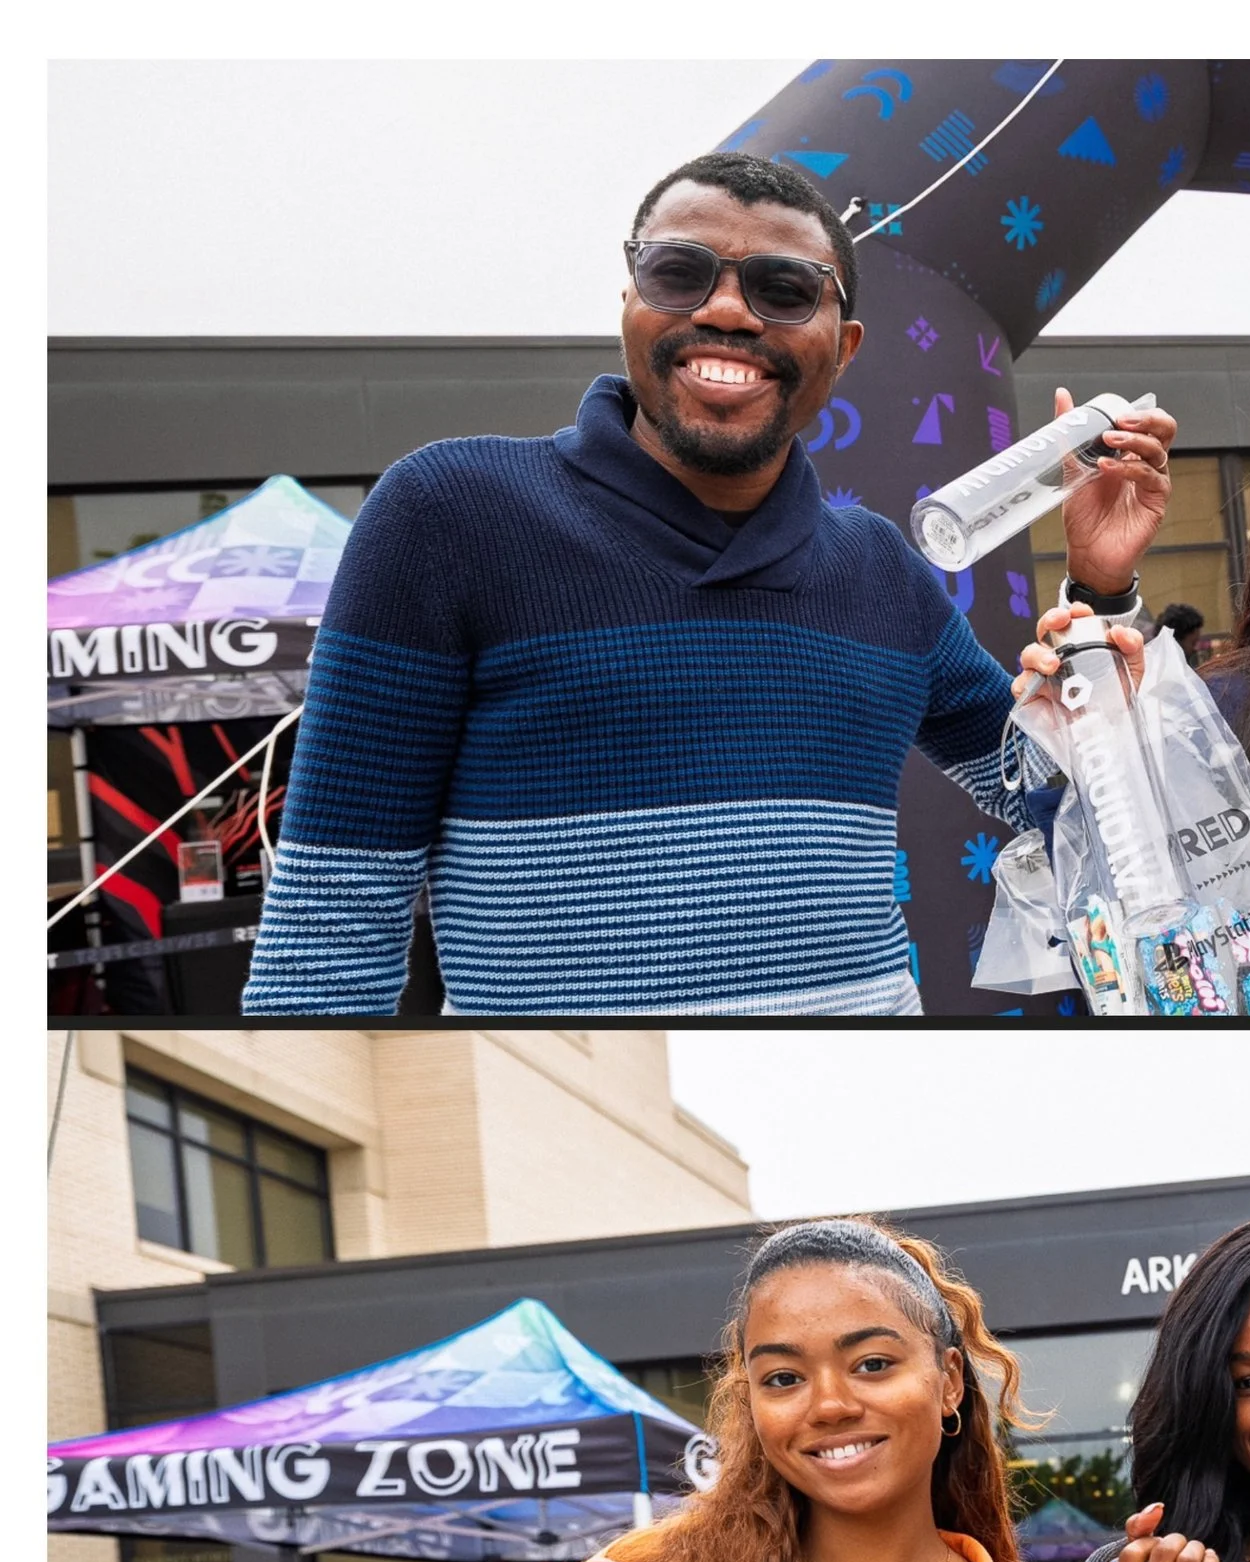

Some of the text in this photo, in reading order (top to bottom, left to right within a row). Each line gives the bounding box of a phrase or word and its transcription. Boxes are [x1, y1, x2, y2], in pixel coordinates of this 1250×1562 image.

[47, 617, 278, 678] MING
[1180, 807, 1250, 863] RED
[1121, 1252, 1198, 1295] ARK
[355, 1428, 582, 1496] ZONE
